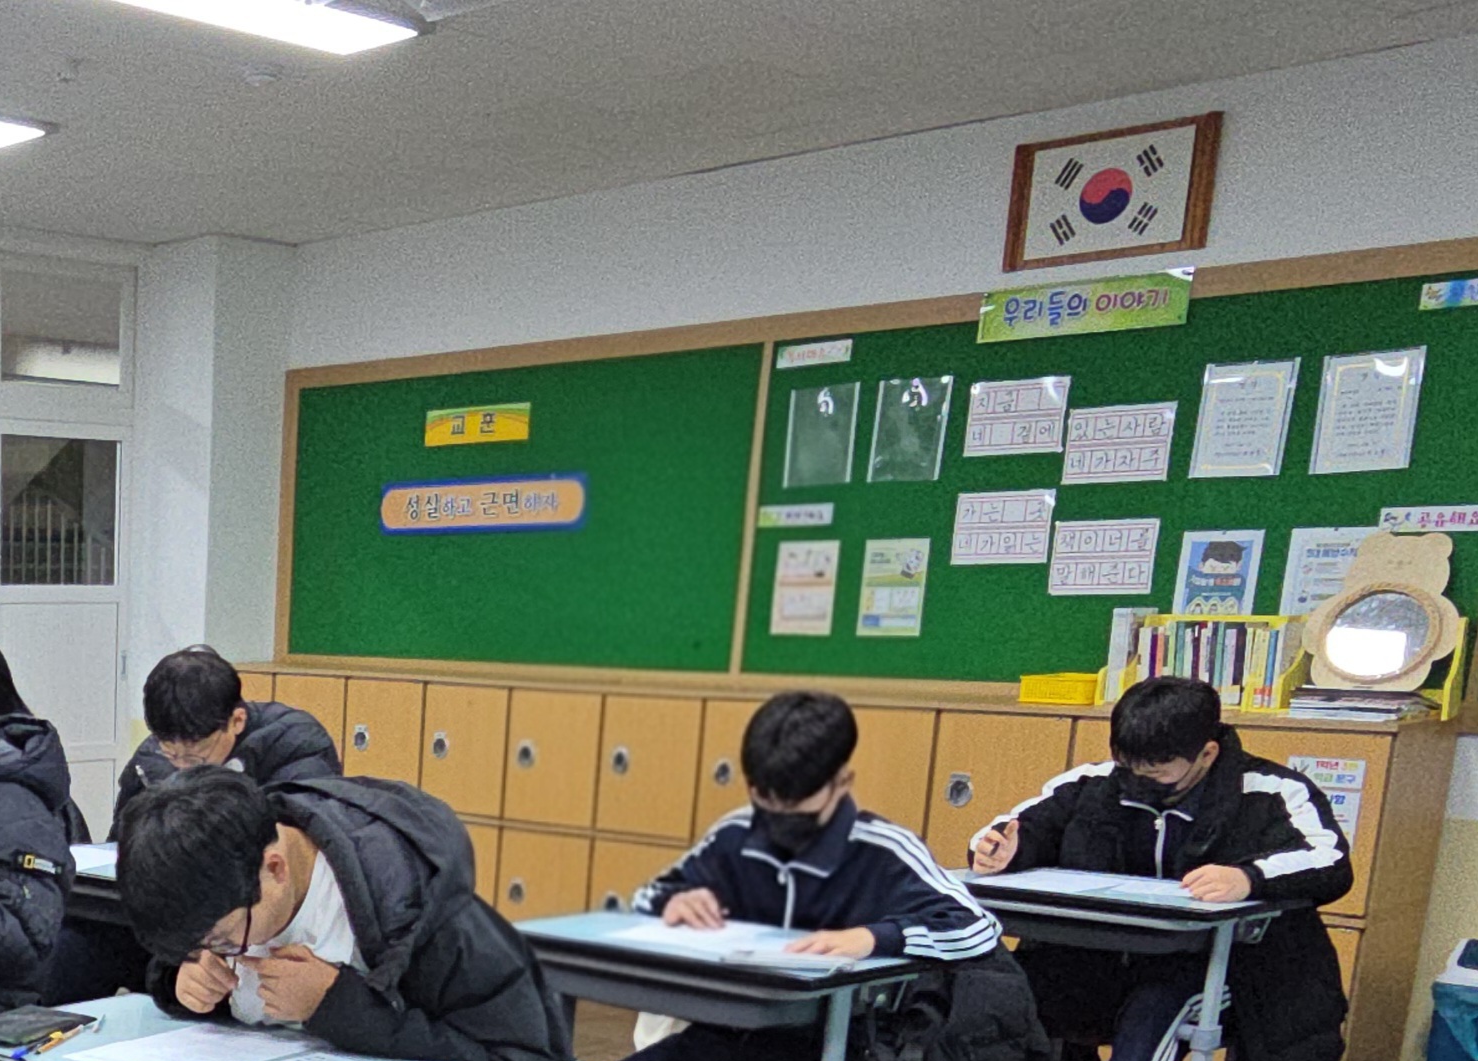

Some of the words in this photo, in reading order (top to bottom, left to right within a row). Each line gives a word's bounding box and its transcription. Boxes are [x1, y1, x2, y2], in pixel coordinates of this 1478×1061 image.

[1003, 290, 1088, 328] 우리들의
[1095, 288, 1170, 312] 이야기
[406, 493, 472, 521] 성실하고
[479, 488, 559, 515] 근면하자
